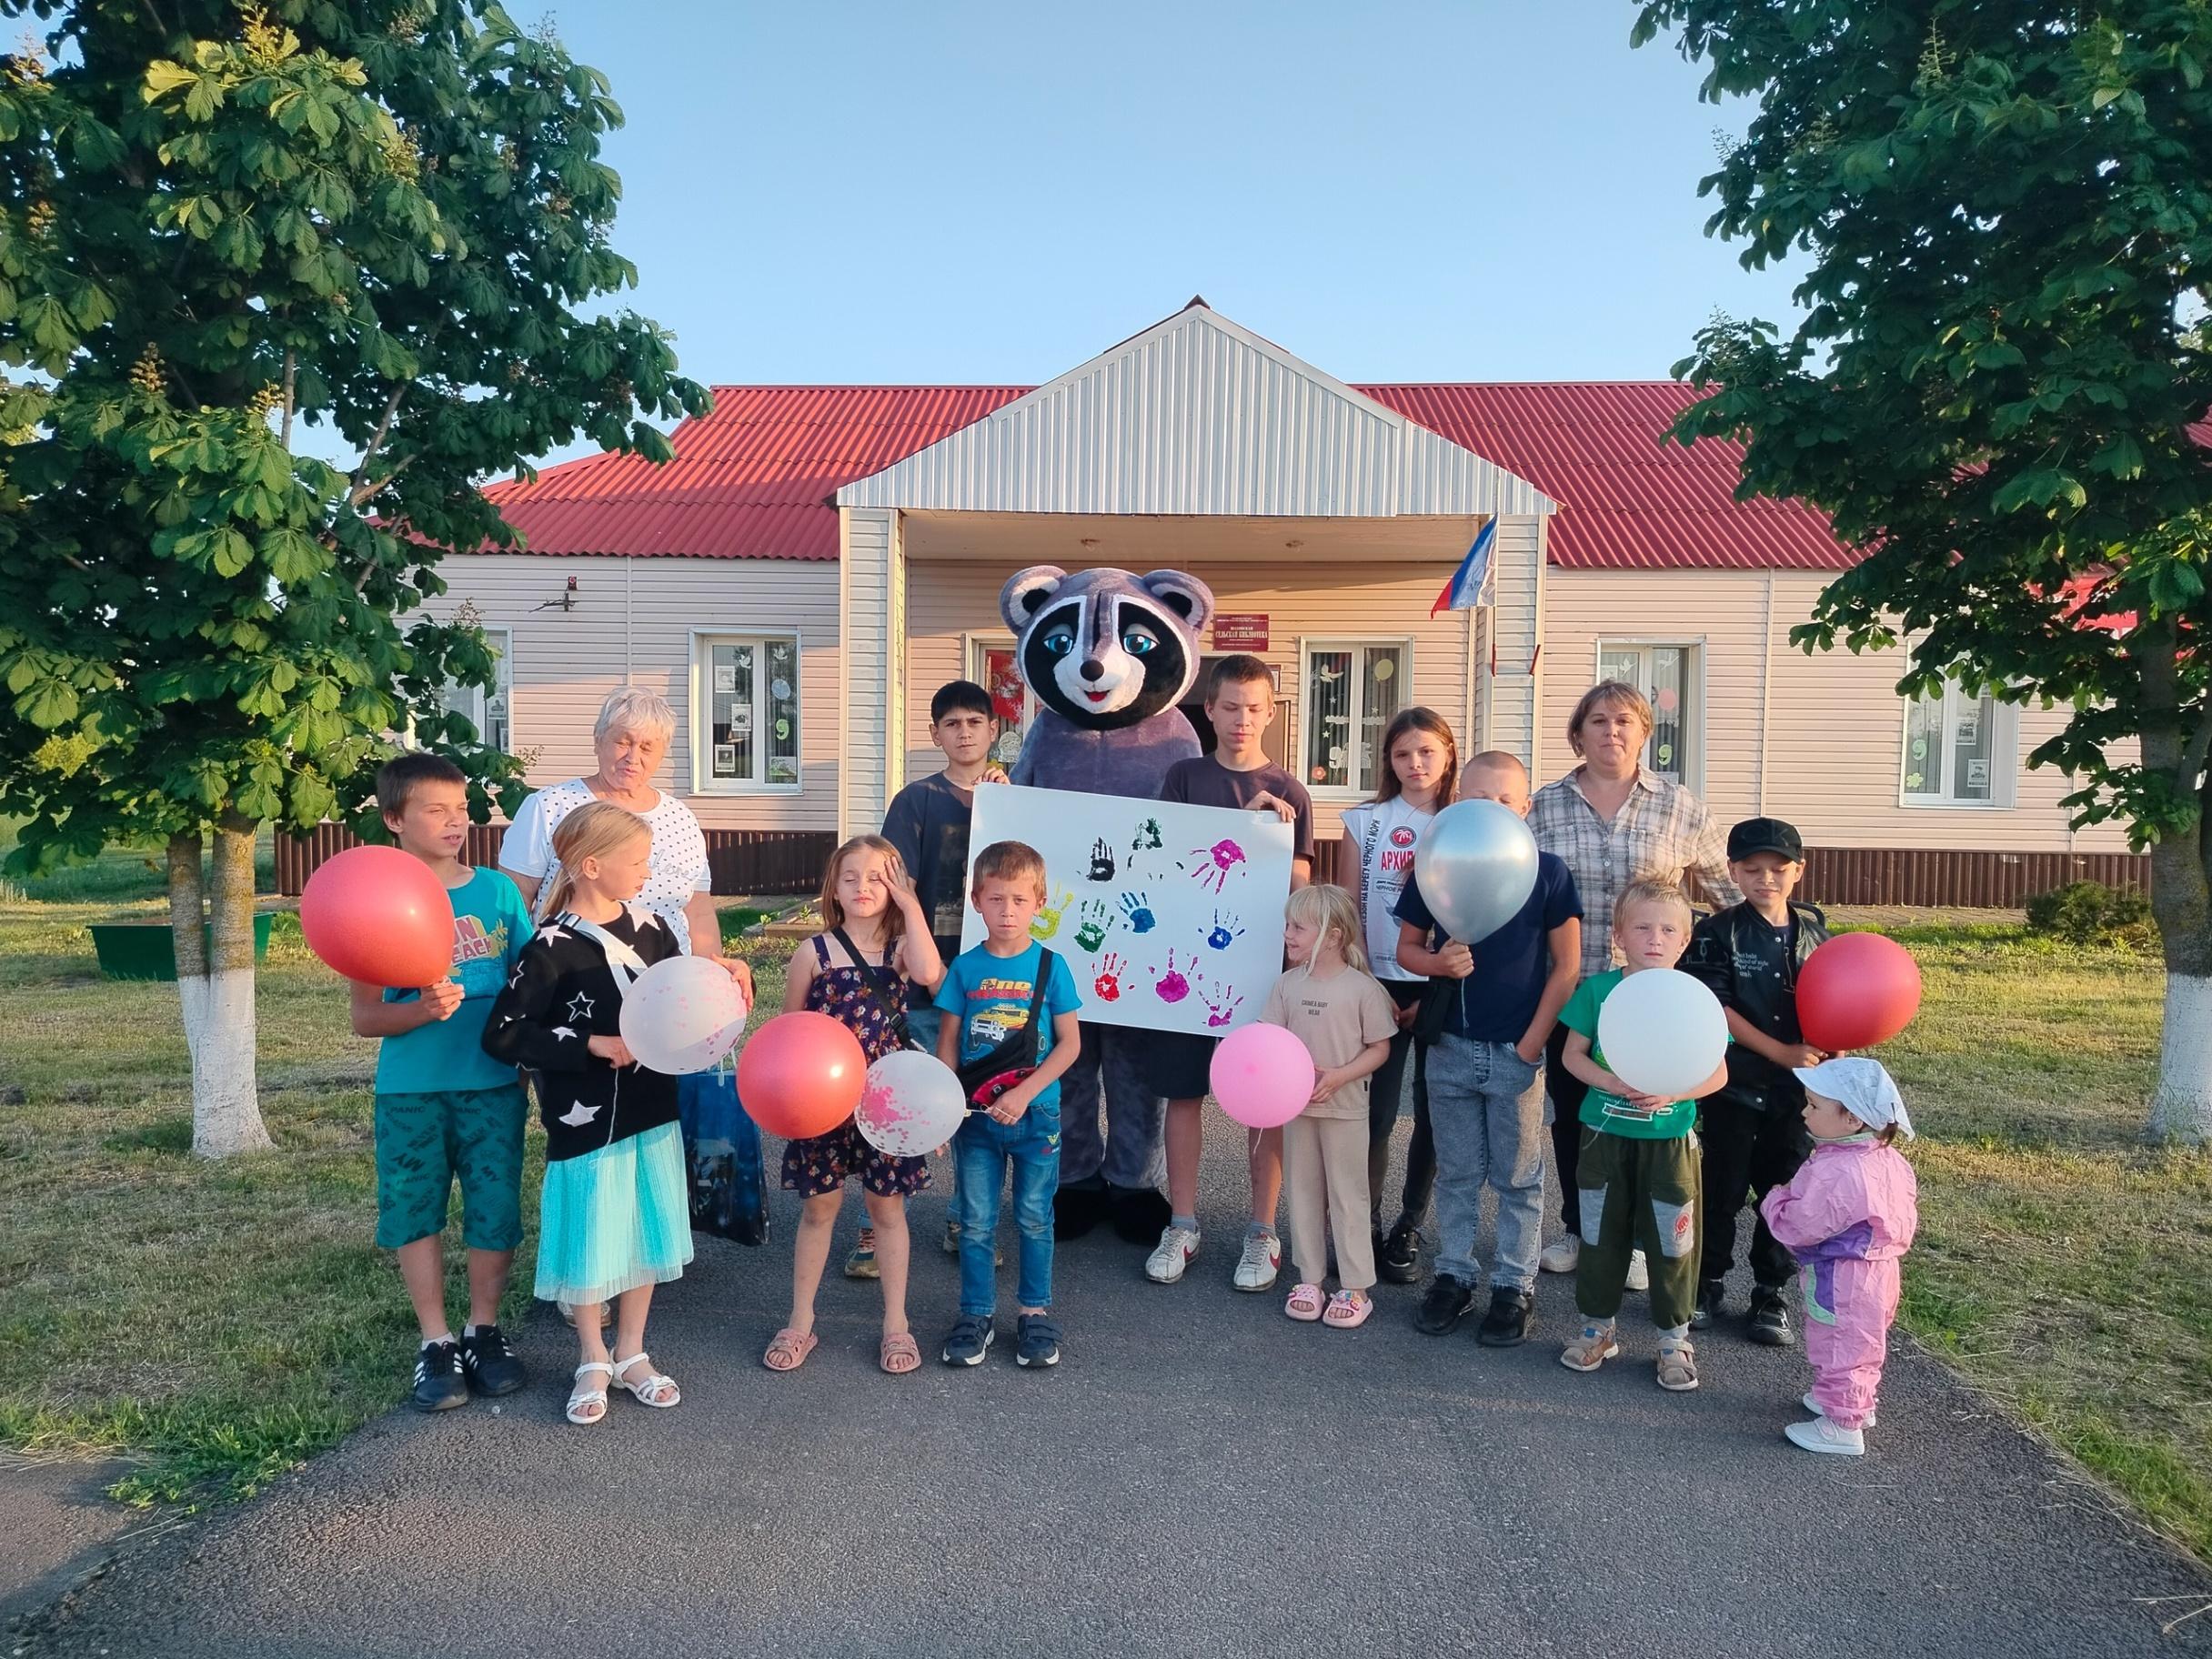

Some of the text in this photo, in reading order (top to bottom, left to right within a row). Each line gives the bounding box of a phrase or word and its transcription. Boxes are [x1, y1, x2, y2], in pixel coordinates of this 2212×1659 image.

[1363, 838, 1378, 867] ЧЕРНОГО
[1362, 867, 1371, 891] БЕРЕГУ
[390, 1105, 426, 1114] PANIC
